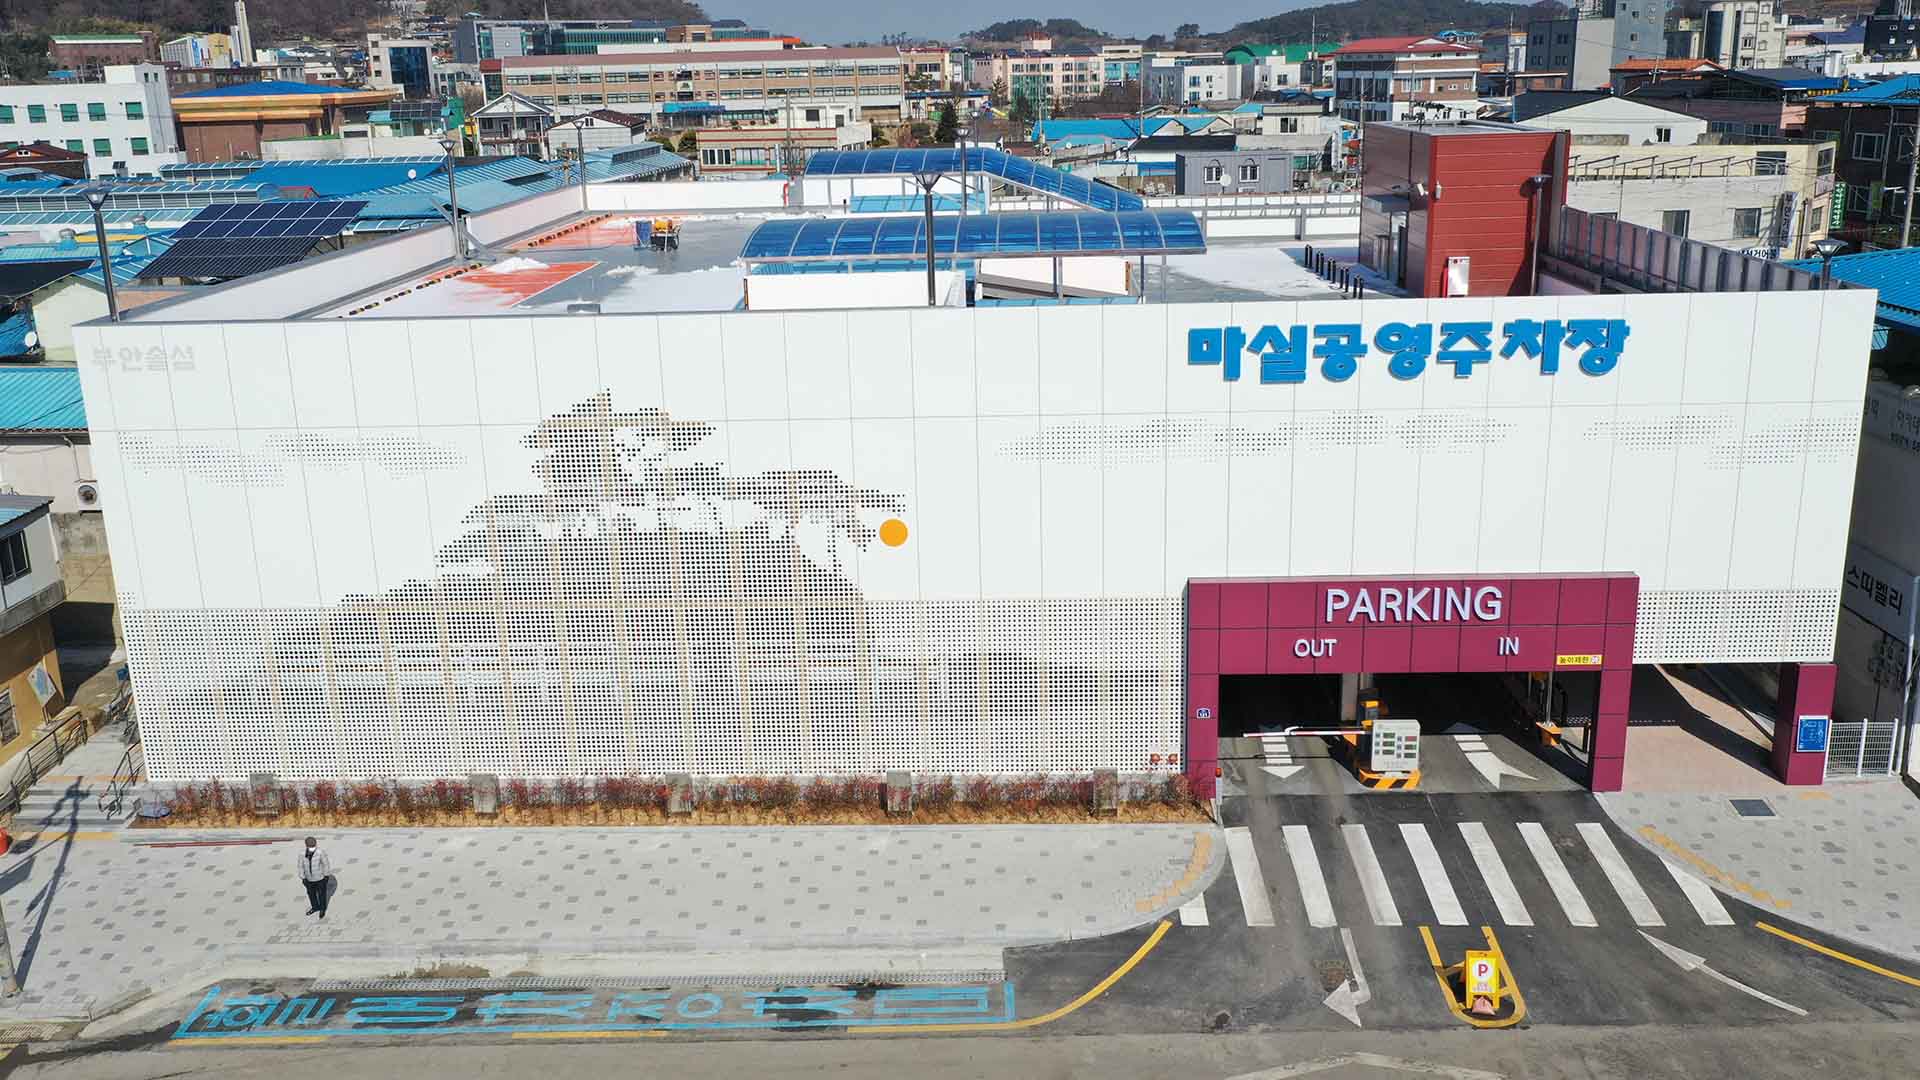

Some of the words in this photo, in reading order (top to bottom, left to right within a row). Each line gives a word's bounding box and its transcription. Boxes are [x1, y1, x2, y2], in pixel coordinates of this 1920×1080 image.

[91, 345, 195, 372] 부안솔섬
[1188, 318, 1630, 384] 마실공영주차장
[1326, 586, 1503, 623] PARKING
[1294, 638, 1337, 658] OUT
[1498, 636, 1520, 656] IN
[1478, 963, 1489, 977] P
